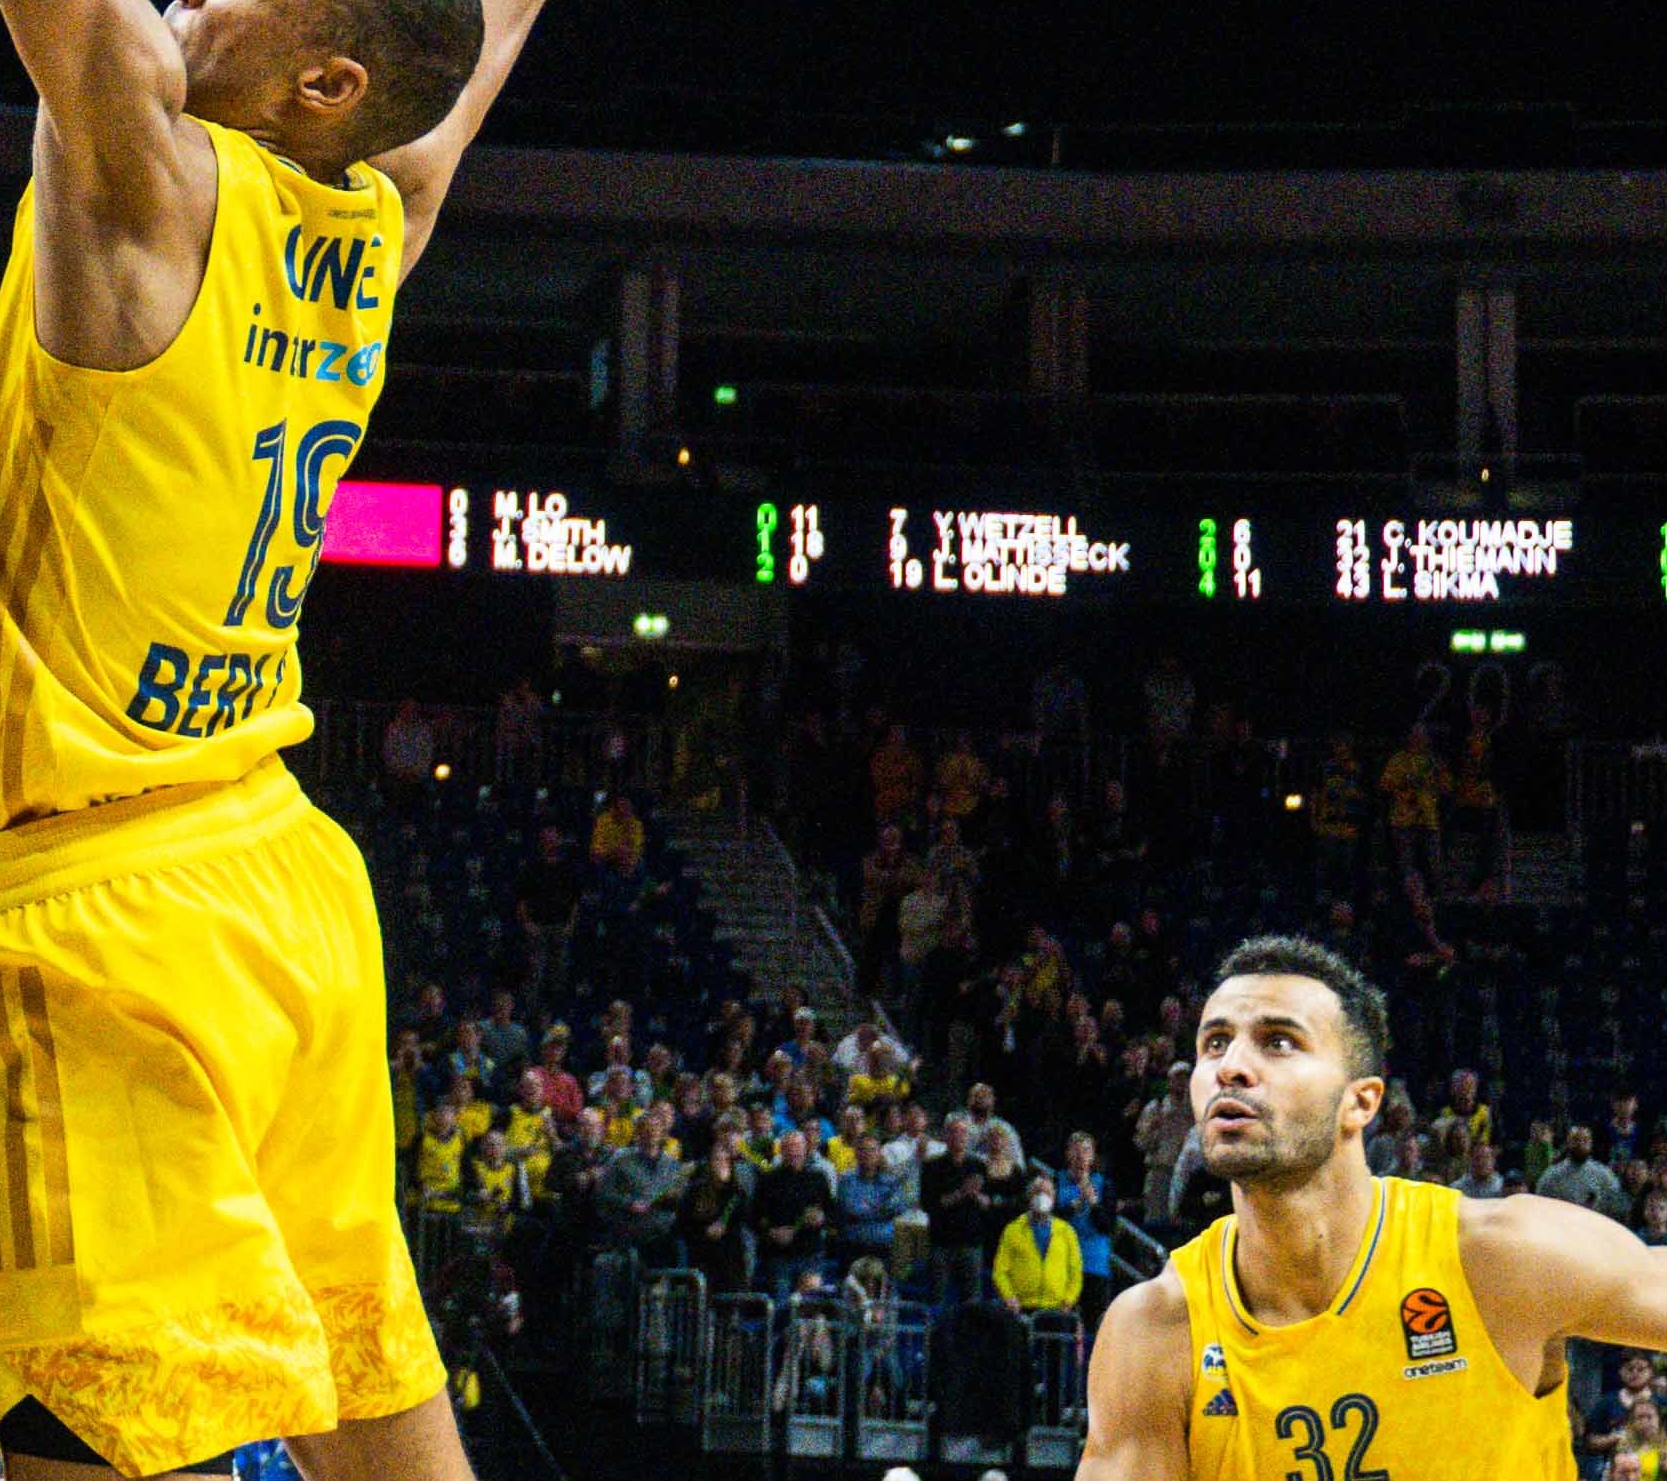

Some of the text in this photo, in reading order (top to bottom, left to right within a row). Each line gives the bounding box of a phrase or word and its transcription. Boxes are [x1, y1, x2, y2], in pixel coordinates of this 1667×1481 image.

[528, 492, 567, 519] LO
[222, 417, 362, 629] 19
[528, 543, 632, 575] DELOW
[964, 564, 1067, 596] OLINDE
[1414, 572, 1499, 601] SIKMA
